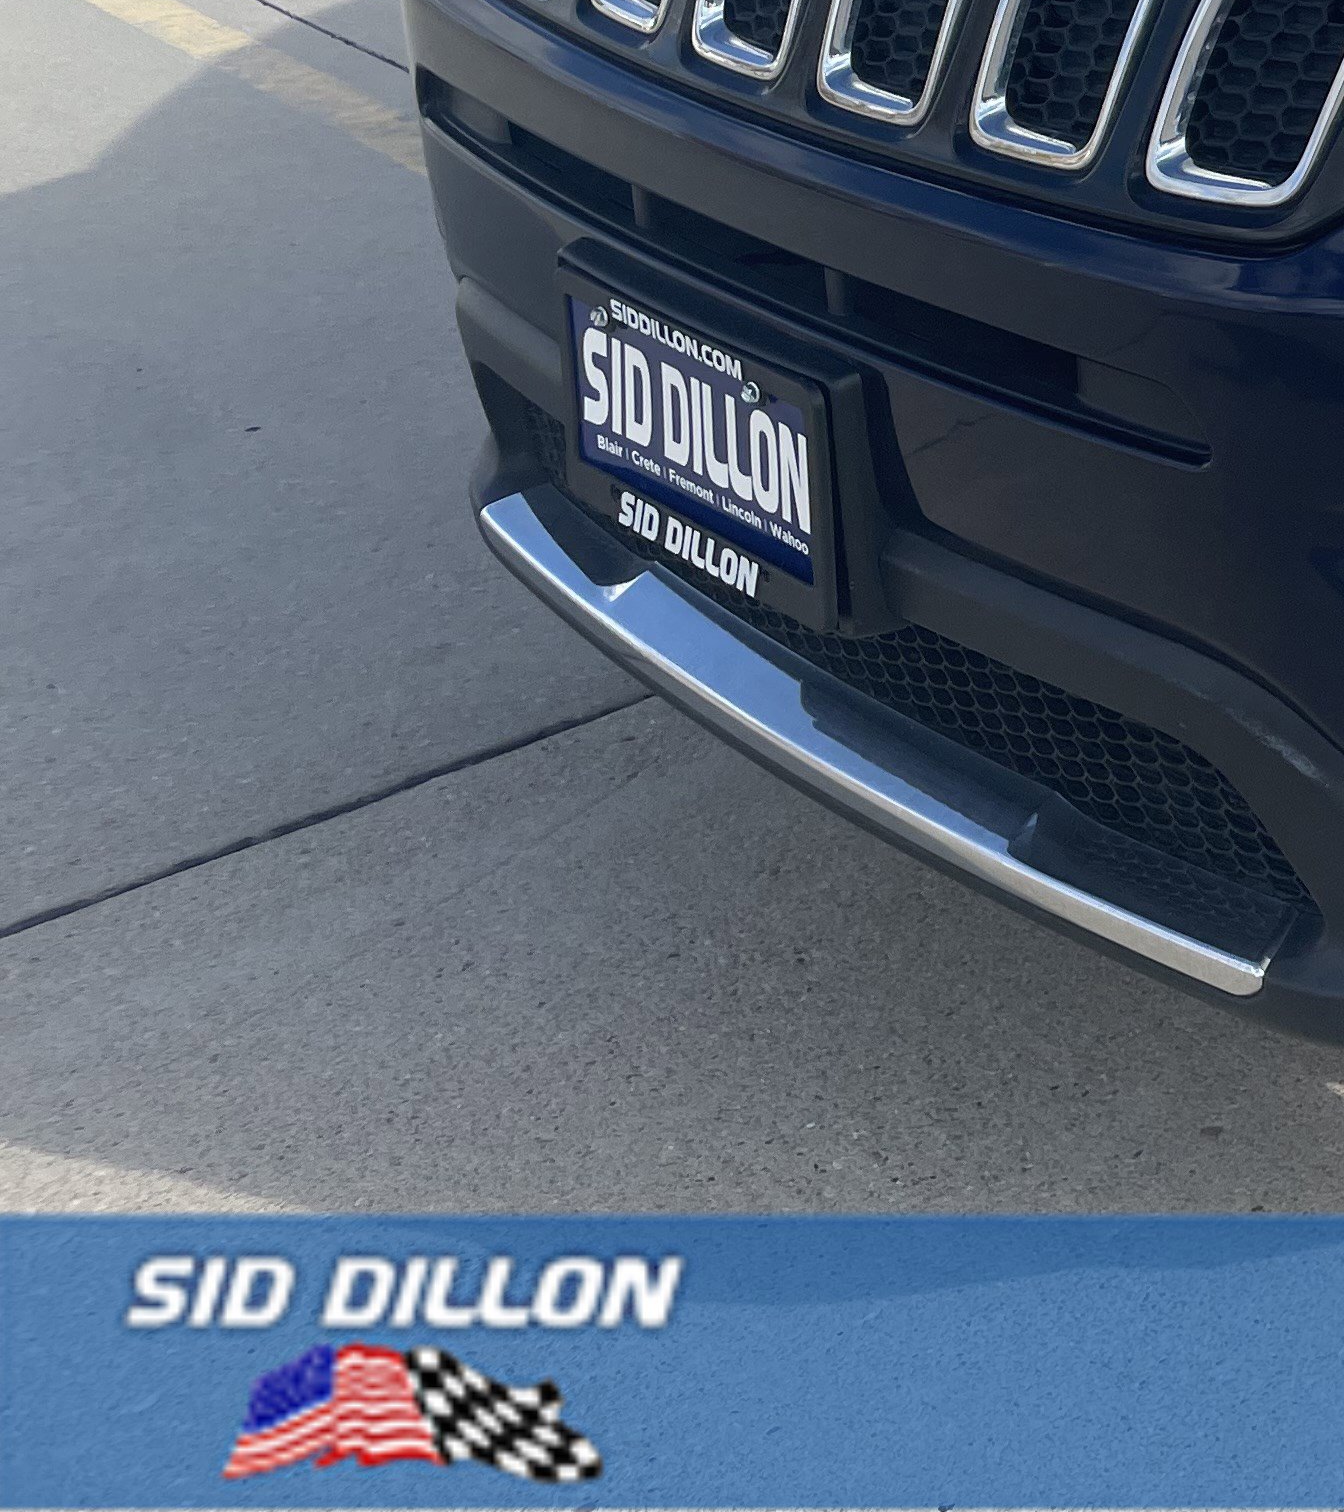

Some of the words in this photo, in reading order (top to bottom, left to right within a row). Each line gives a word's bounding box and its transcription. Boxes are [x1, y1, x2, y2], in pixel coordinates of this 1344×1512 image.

[609, 299, 743, 381] SIDDILLON.COM
[583, 327, 653, 447] SID
[660, 361, 812, 535] DILLON
[597, 434, 624, 457] Blair
[631, 450, 661, 477] Crete
[669, 468, 715, 505] Fremont
[721, 495, 763, 530] Lincoln
[769, 521, 810, 555] Wahoo
[618, 490, 659, 543] SID
[664, 516, 760, 598] DILLON
